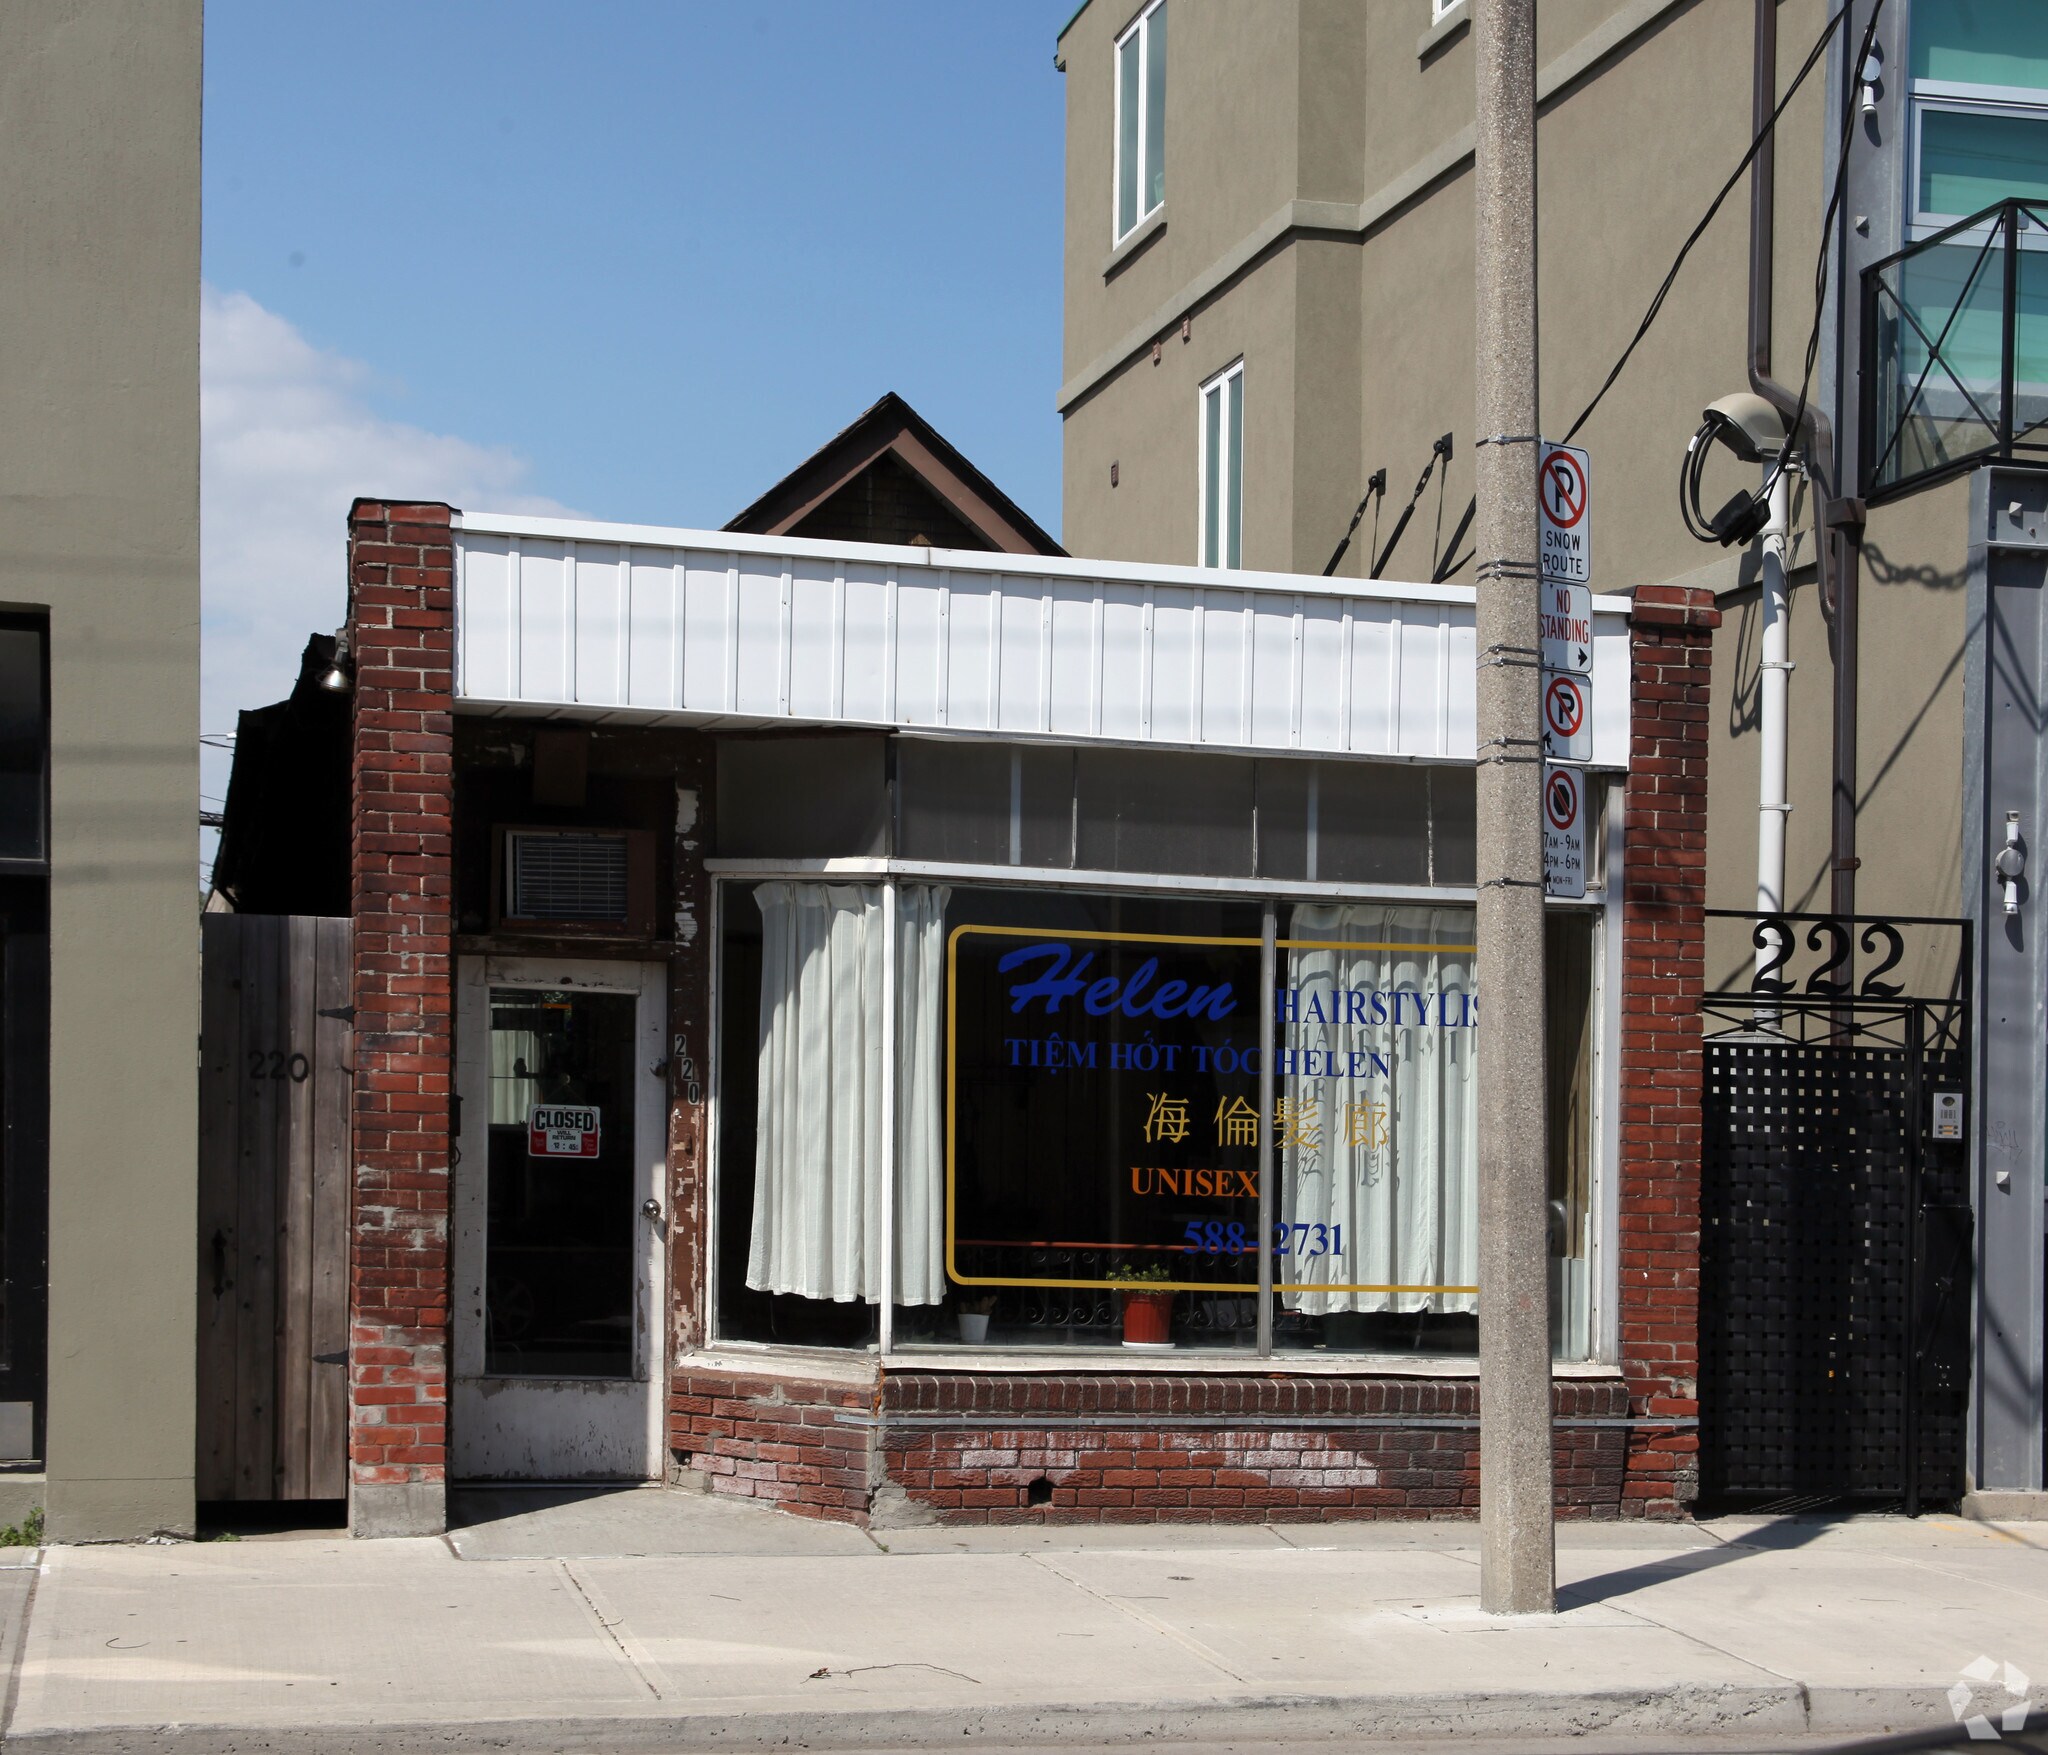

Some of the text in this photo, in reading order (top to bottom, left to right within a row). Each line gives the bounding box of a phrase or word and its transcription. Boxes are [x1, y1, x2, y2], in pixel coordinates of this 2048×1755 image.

[1546, 531, 1580, 551] SNOW
[1543, 553, 1583, 575] ROUTE
[1557, 589, 1571, 615] NO
[1541, 614, 1589, 644] STANDING
[1752, 919, 1905, 997] 222
[998, 943, 1237, 1021] Helen
[248, 1050, 309, 1083] 220
[1004, 1032, 1098, 1074] TIỆM
[1275, 1050, 1392, 1079] HELEN
[535, 1110, 594, 1131] CLOSED
[1130, 1167, 1259, 1197] UNISEX
